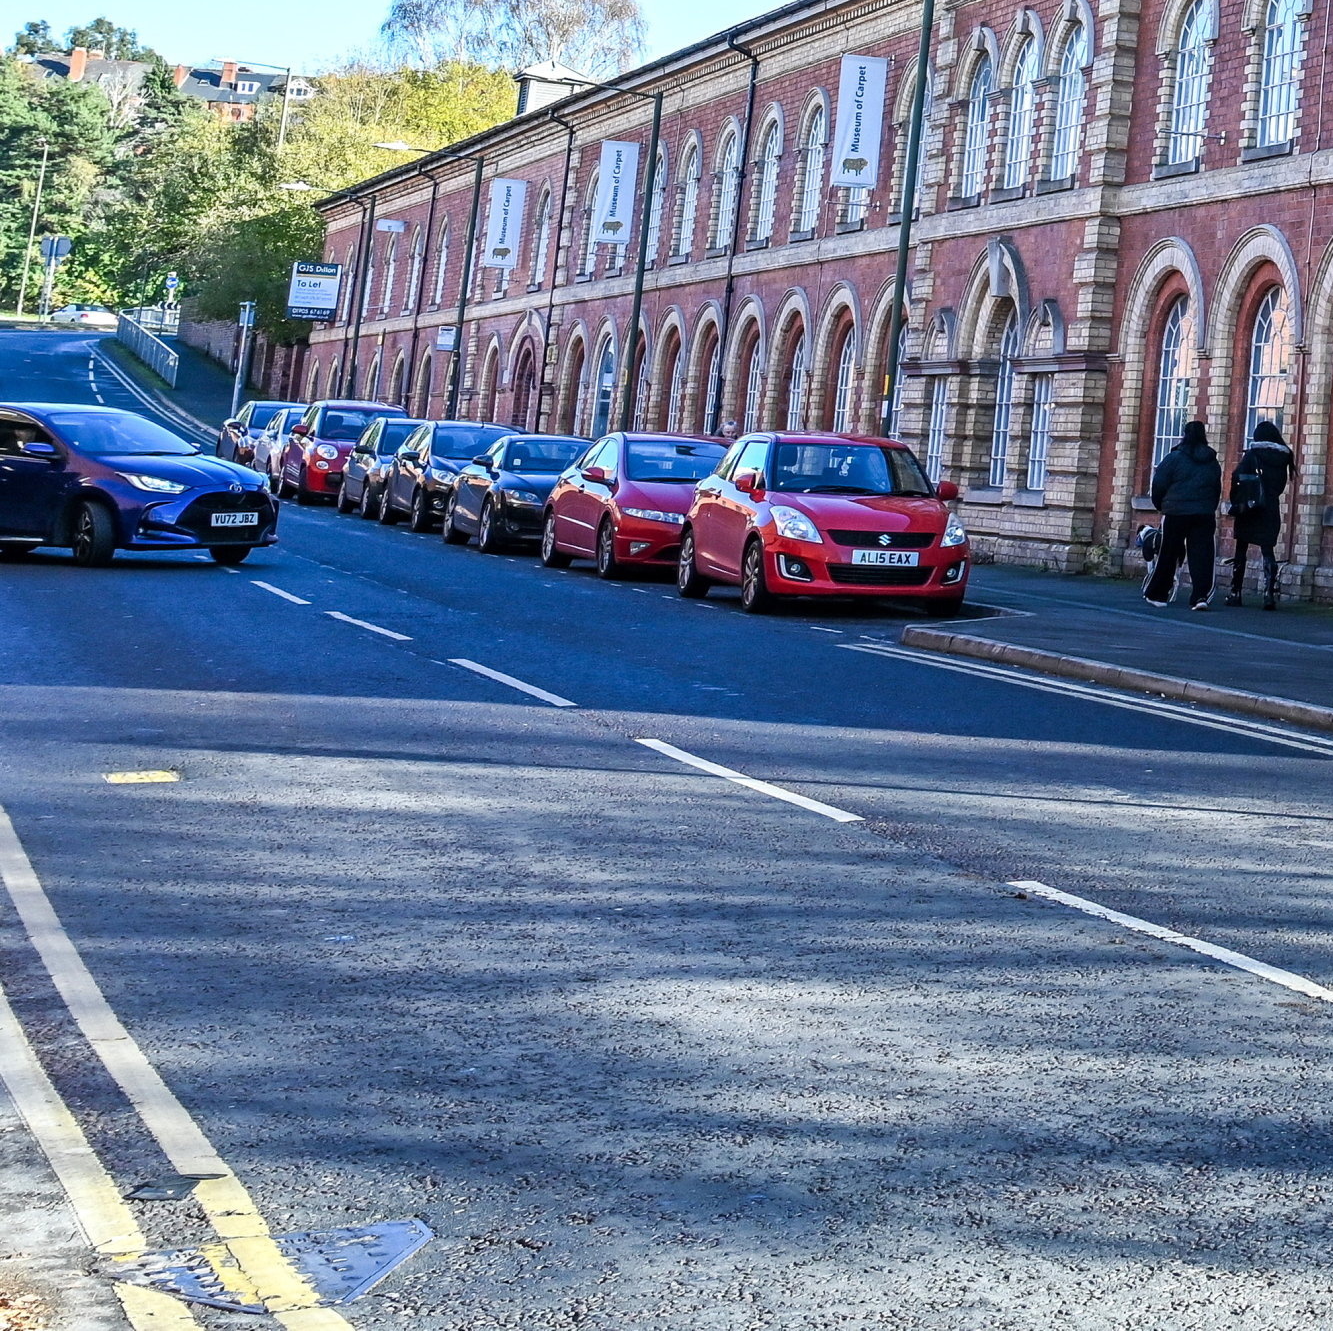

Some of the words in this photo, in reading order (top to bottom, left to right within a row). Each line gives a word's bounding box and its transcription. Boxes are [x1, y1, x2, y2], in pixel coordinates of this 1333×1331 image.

[855, 66, 867, 98] Carpet
[855, 99, 863, 110] of
[851, 111, 862, 153] Museum
[613, 150, 623, 174] Carpet
[503, 185, 512, 207] Carpet
[609, 182, 619, 217] Museum
[499, 215, 508, 244] Museum
[860, 552, 886, 563] AL15
[888, 553, 912, 565] EAX
